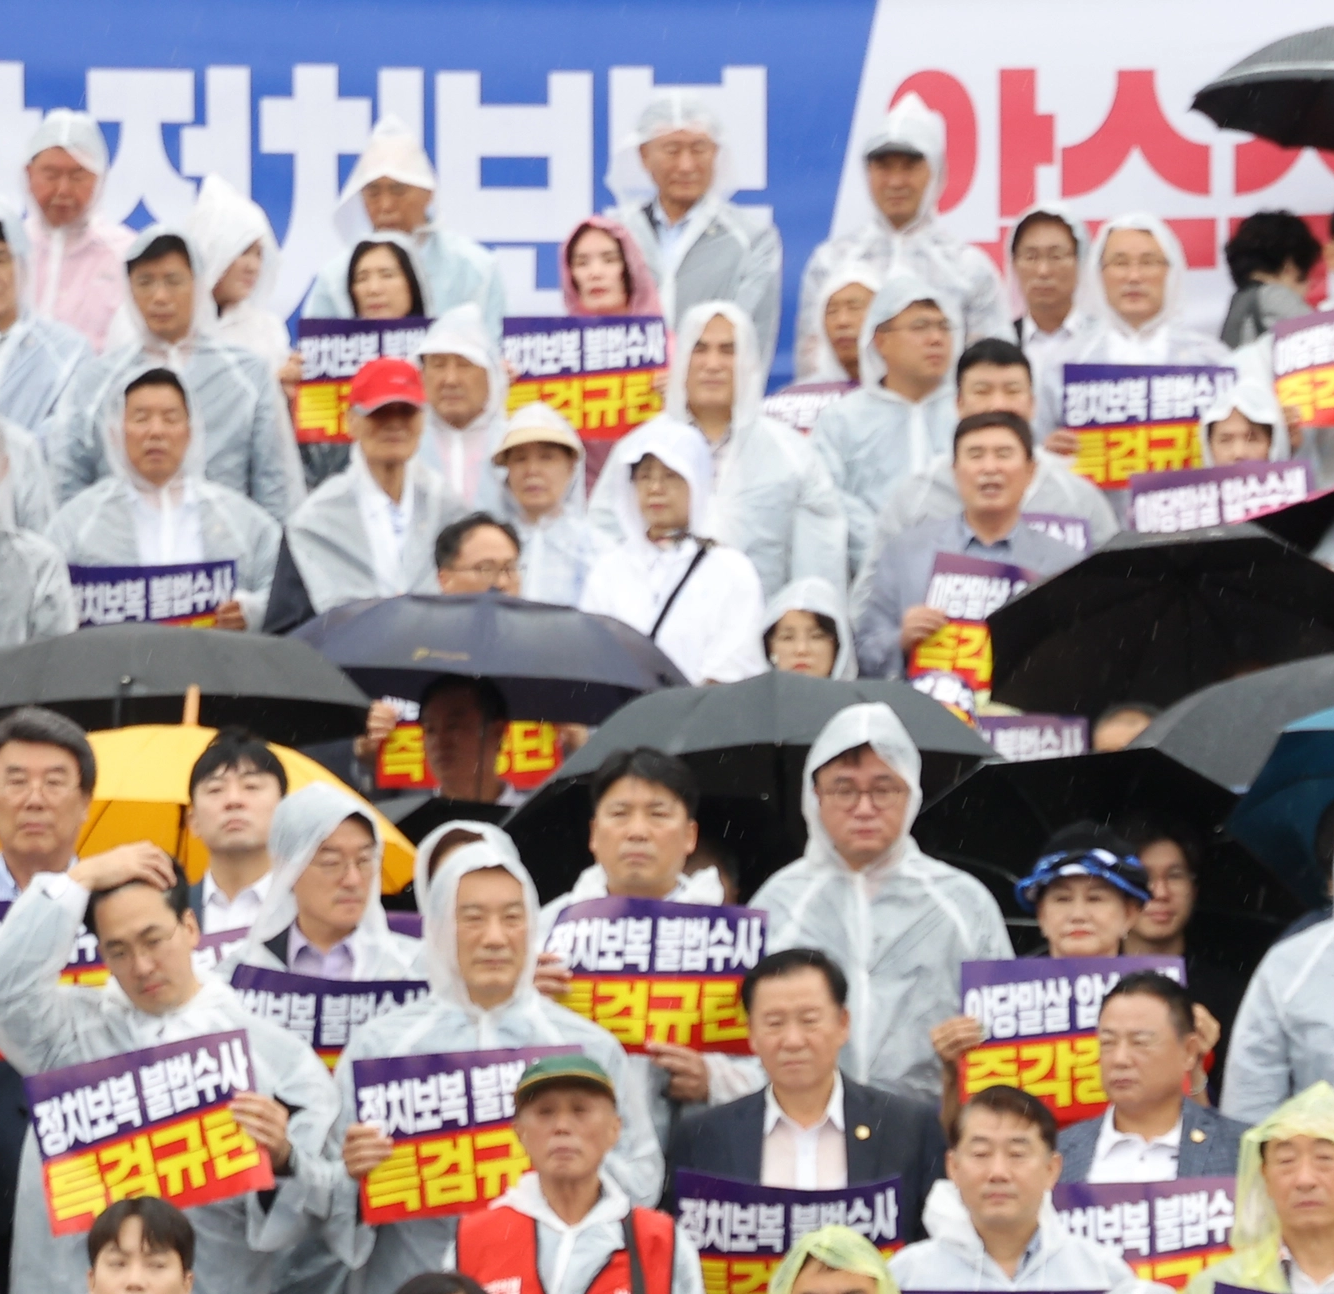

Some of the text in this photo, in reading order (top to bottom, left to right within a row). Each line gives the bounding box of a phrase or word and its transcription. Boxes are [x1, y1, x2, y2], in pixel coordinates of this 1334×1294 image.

[504, 322, 665, 376] 정치보복 불법수사
[1073, 420, 1201, 477] 특검규
[1133, 488, 1218, 532] 야당말살
[151, 568, 234, 620] 불법수사
[914, 624, 992, 679] 즉각
[656, 916, 762, 969] 불법수사
[967, 978, 1072, 1041] 야당말살
[35, 1038, 249, 1159] 정치보복 불법수사
[359, 1069, 467, 1136] 정치보복
[45, 1109, 262, 1219] 특검규탄
[369, 1135, 533, 1215] 특검규
[678, 1198, 785, 1254] 정치보복
